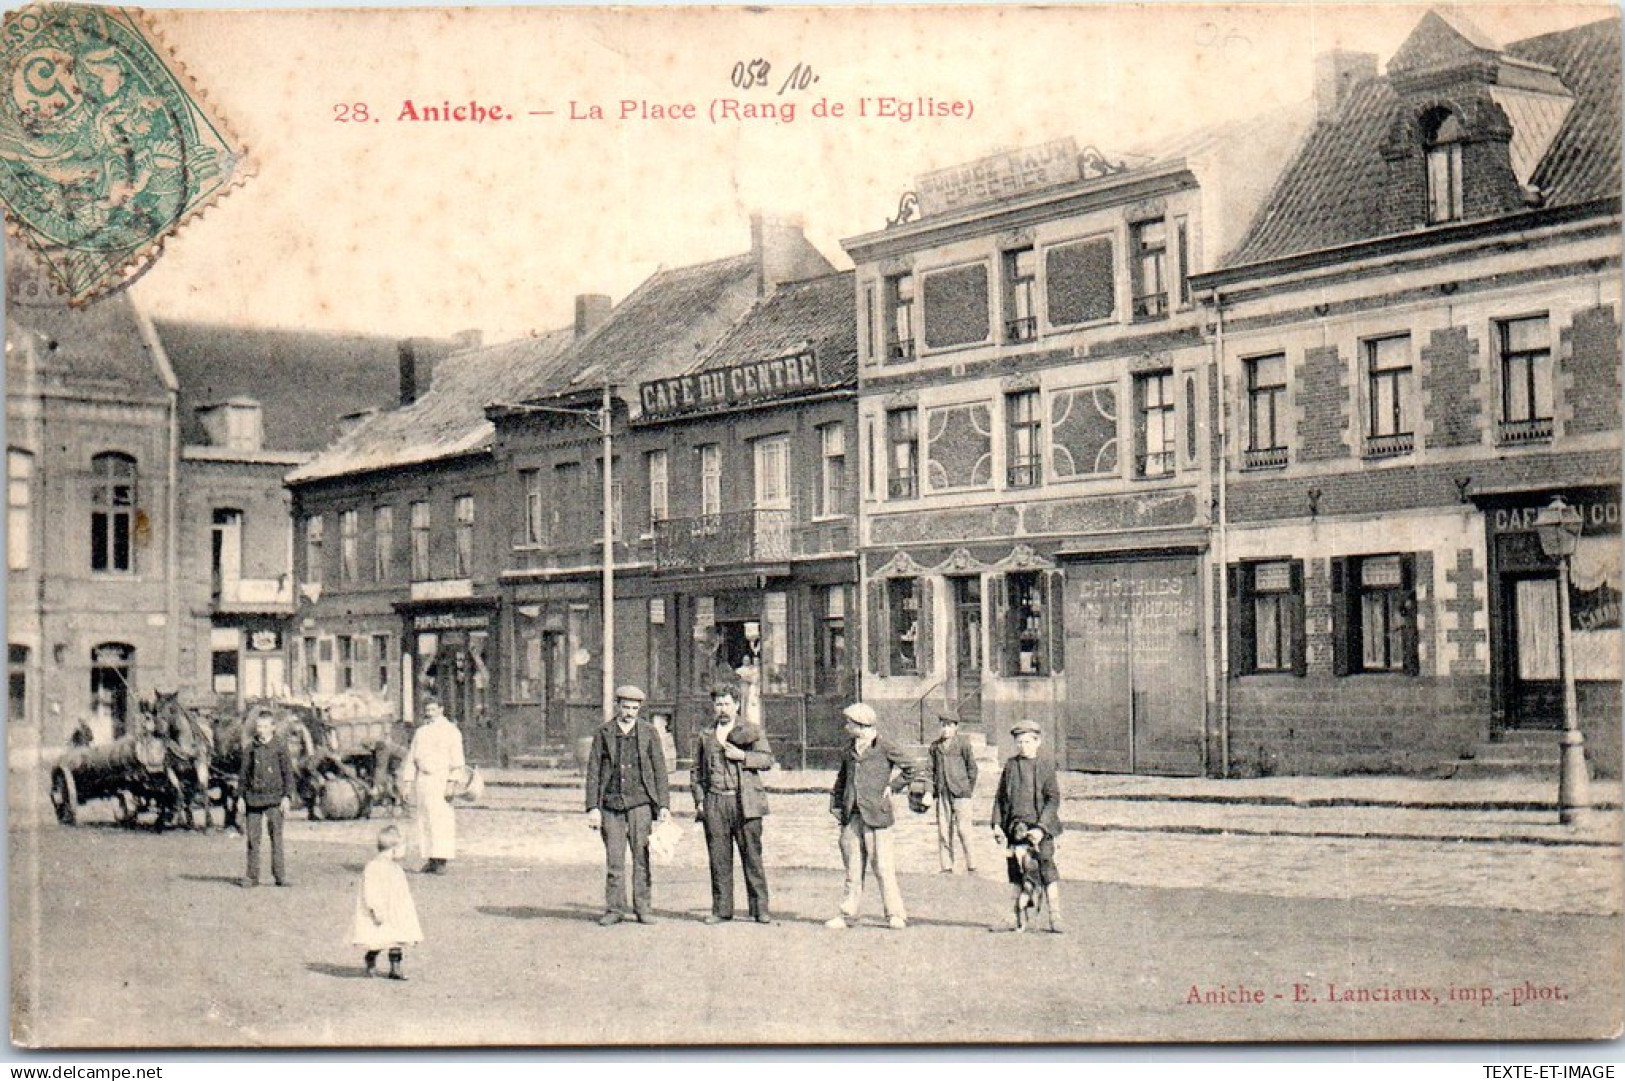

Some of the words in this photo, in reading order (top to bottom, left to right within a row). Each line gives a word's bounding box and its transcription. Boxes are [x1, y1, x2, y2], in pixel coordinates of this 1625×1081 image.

[643, 377, 695, 413] CAFE
[699, 371, 726, 399] DU
[731, 353, 816, 395] CENTRE
[1495, 507, 1537, 530] CAF
